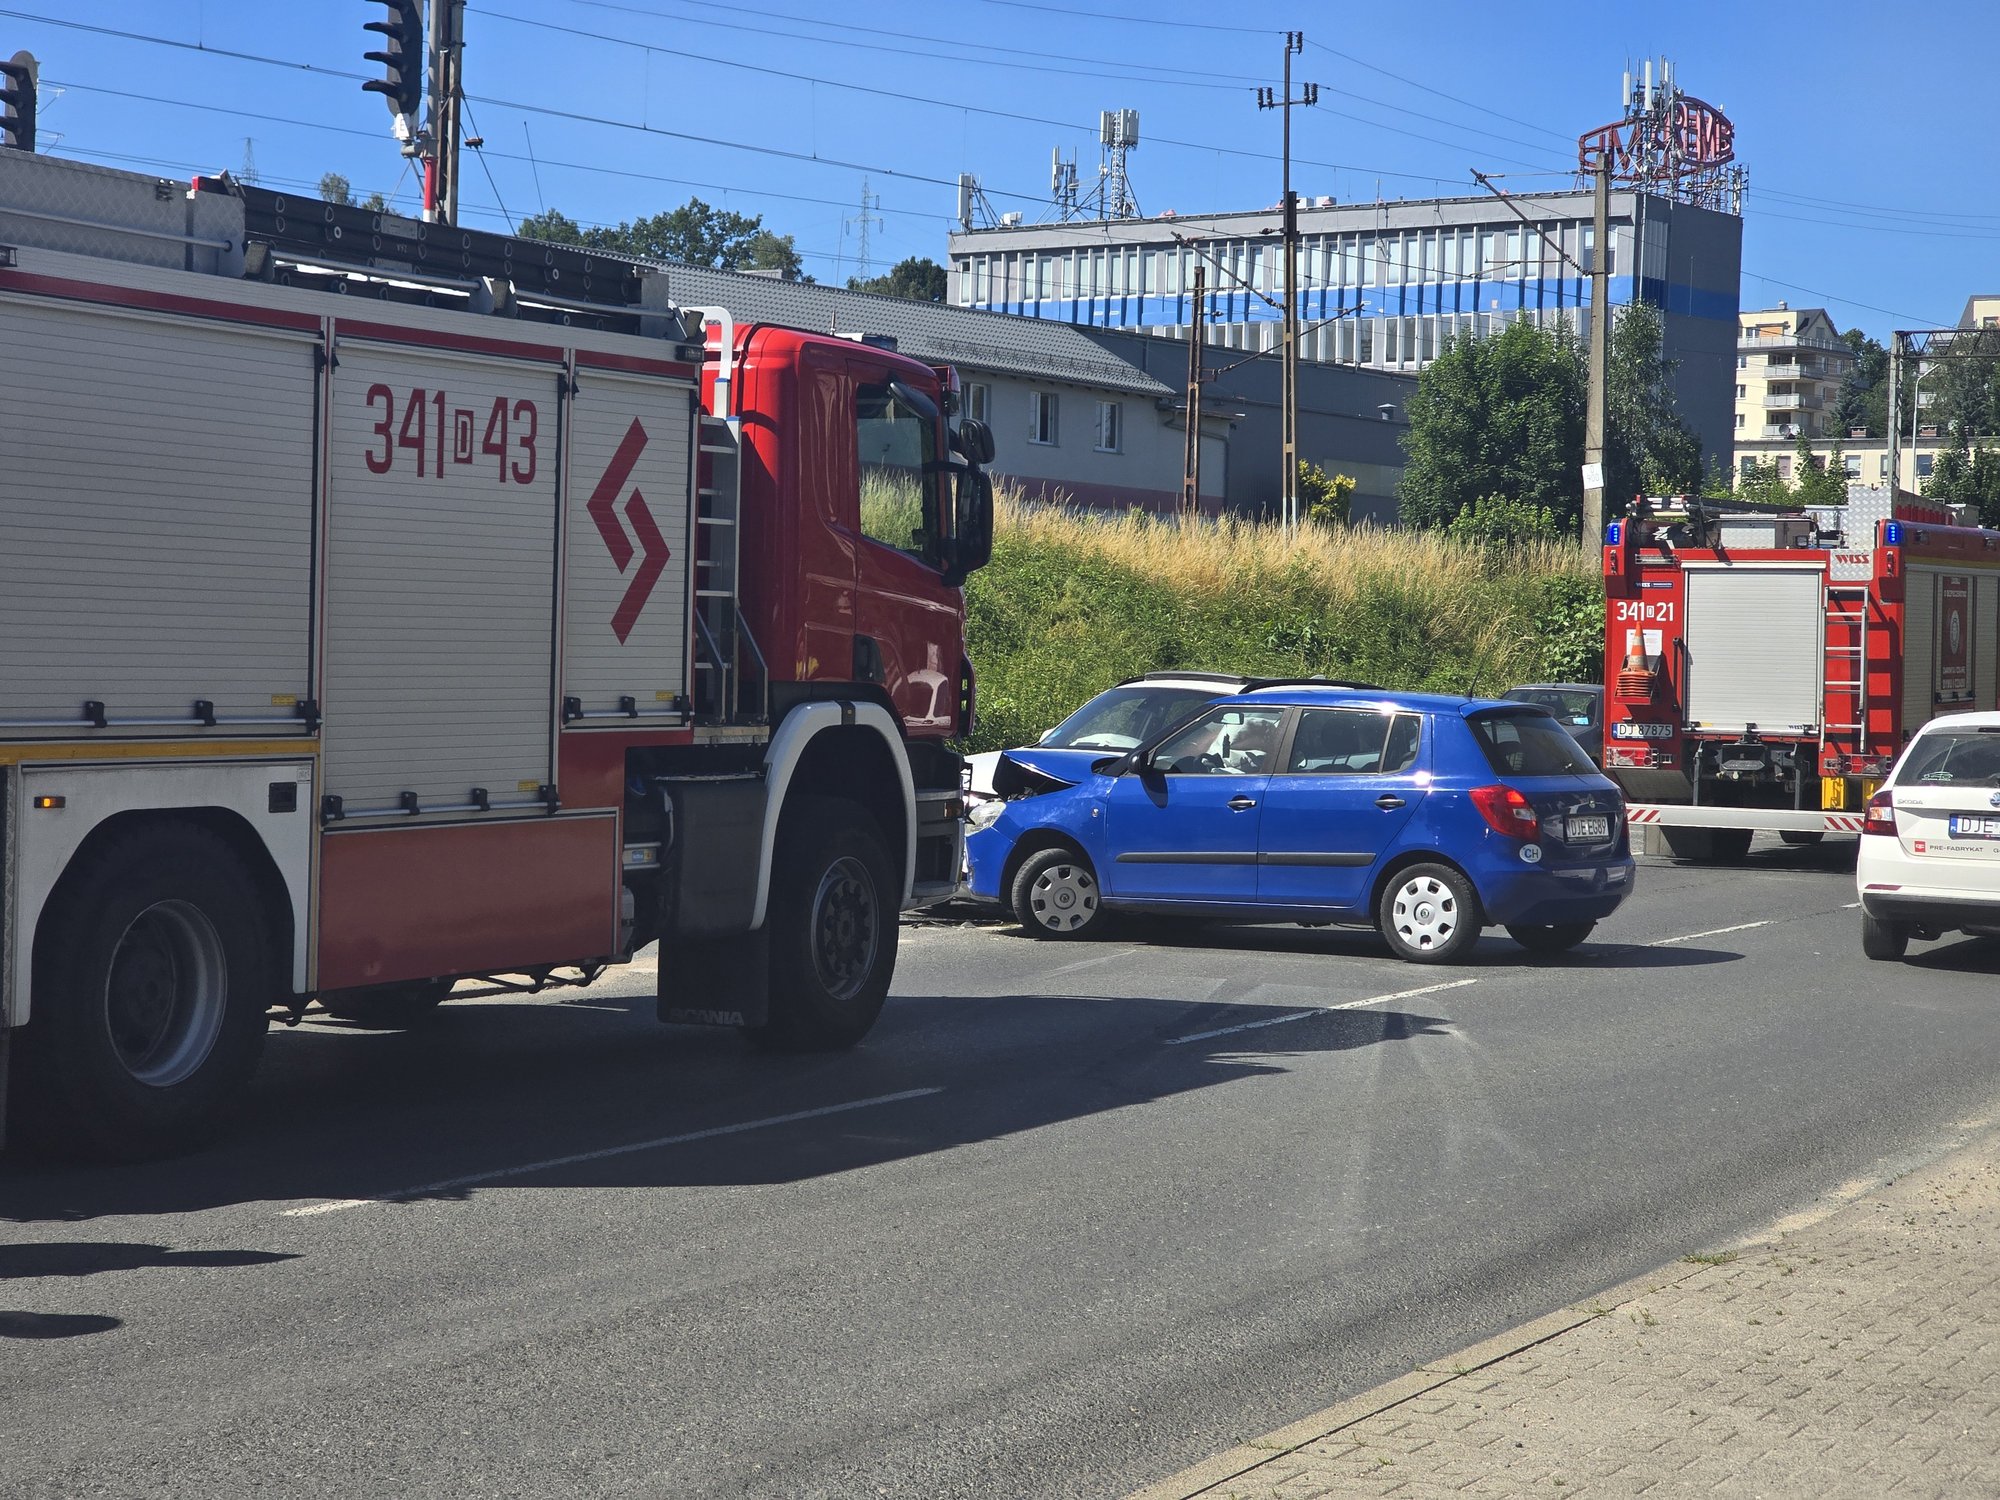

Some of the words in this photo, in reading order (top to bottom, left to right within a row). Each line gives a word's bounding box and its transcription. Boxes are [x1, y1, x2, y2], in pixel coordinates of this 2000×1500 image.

[1834, 554, 1870, 565] WISS
[1619, 724, 1636, 735] DJ
[1638, 724, 1671, 736] 87875
[1961, 816, 1994, 833] DJE
[1524, 848, 1539, 859] CH
[1929, 845, 1984, 853] PRE-FABRYKAT
